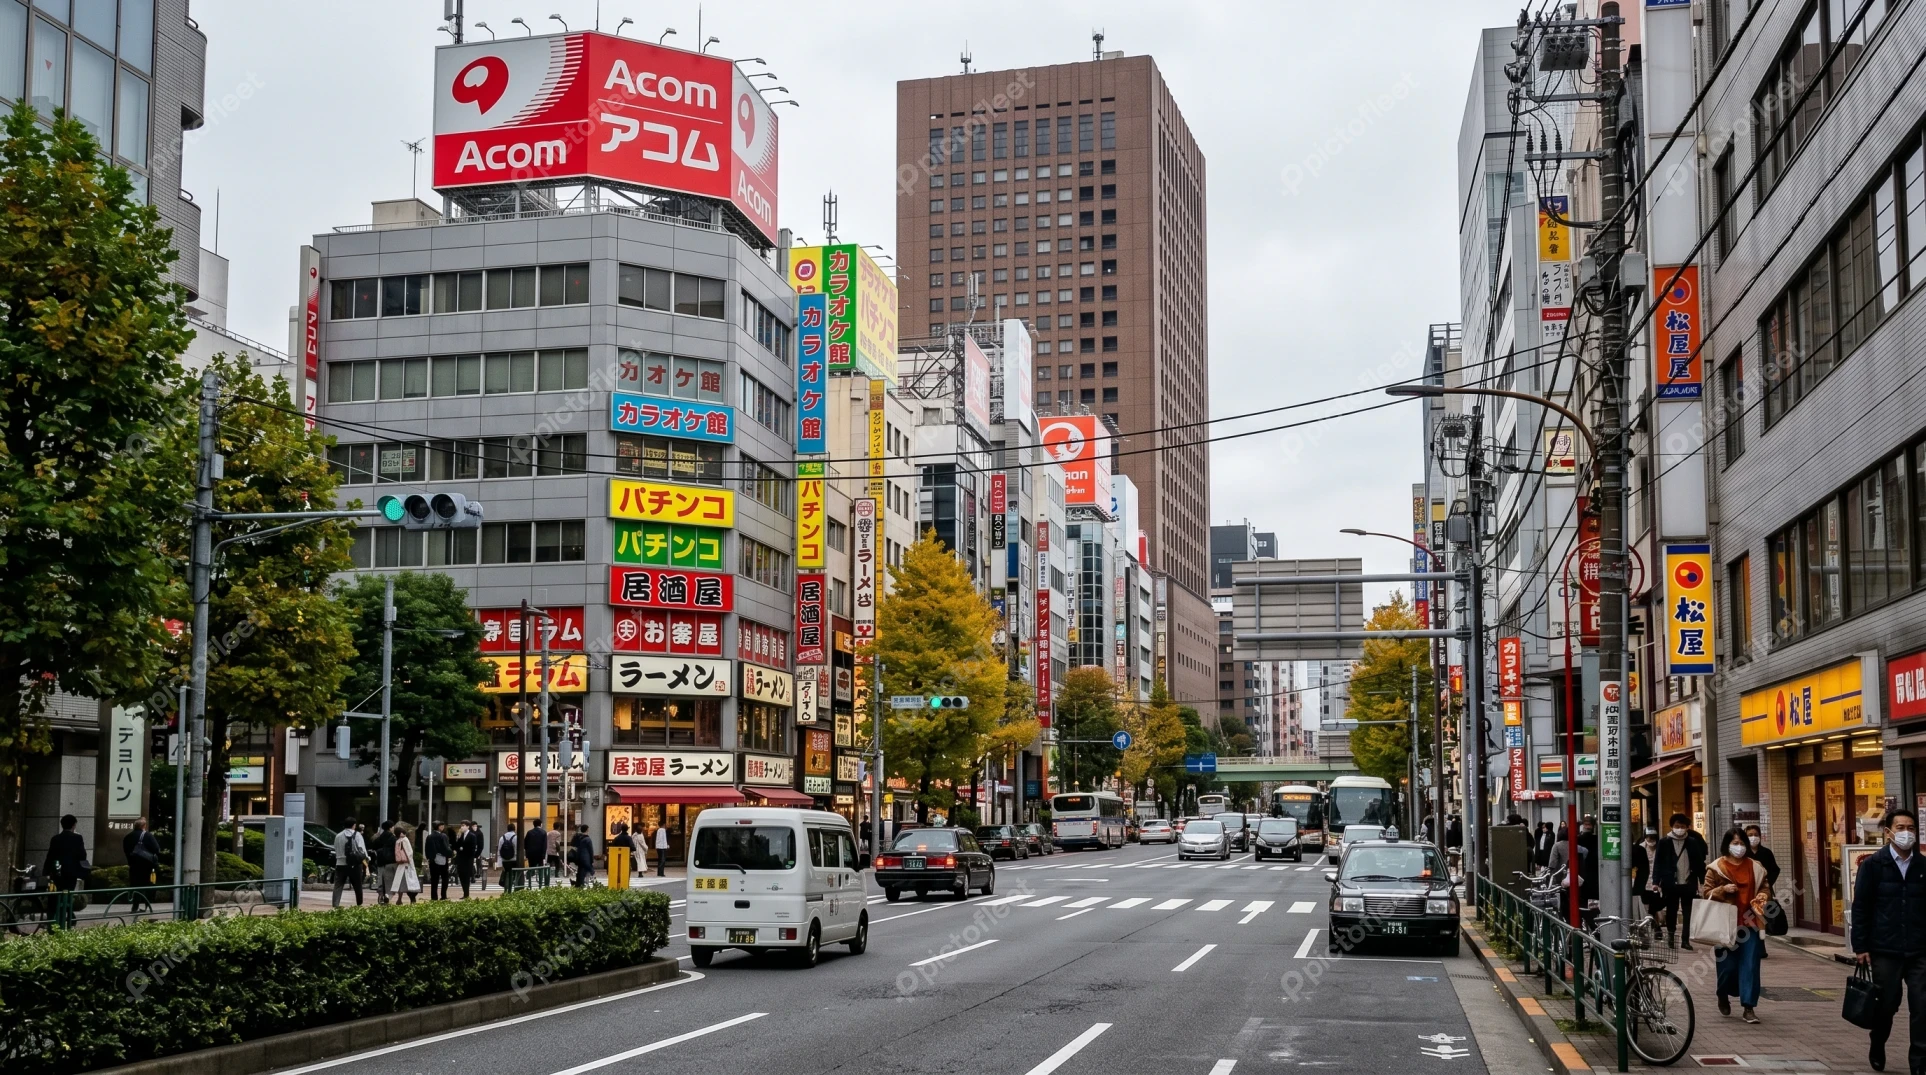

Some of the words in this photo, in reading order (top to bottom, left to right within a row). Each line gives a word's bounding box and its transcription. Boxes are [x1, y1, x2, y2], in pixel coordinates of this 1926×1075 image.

[604, 59, 717, 110] Acom
[454, 139, 567, 173] Acom
[601, 112, 720, 171] アコム
[737, 169, 772, 227] Acom
[829, 250, 850, 363] カラオケ館
[620, 360, 720, 393] カオケ館
[801, 306, 822, 440] カラオケ館
[618, 401, 728, 436] カラオケ館
[619, 487, 725, 520] パチンコ
[802, 480, 821, 560] パチンコ
[617, 530, 719, 561] パチンコ
[621, 572, 723, 606] 居酒屋
[800, 581, 822, 647] 居酒屋
[1674, 595, 1707, 657] 松屋
[619, 661, 715, 691] ラーメン
[756, 670, 785, 700] ラーメン
[1790, 686, 1813, 728] 松屋
[613, 756, 666, 776] 居酒屋
[669, 757, 730, 777] ラーメン
